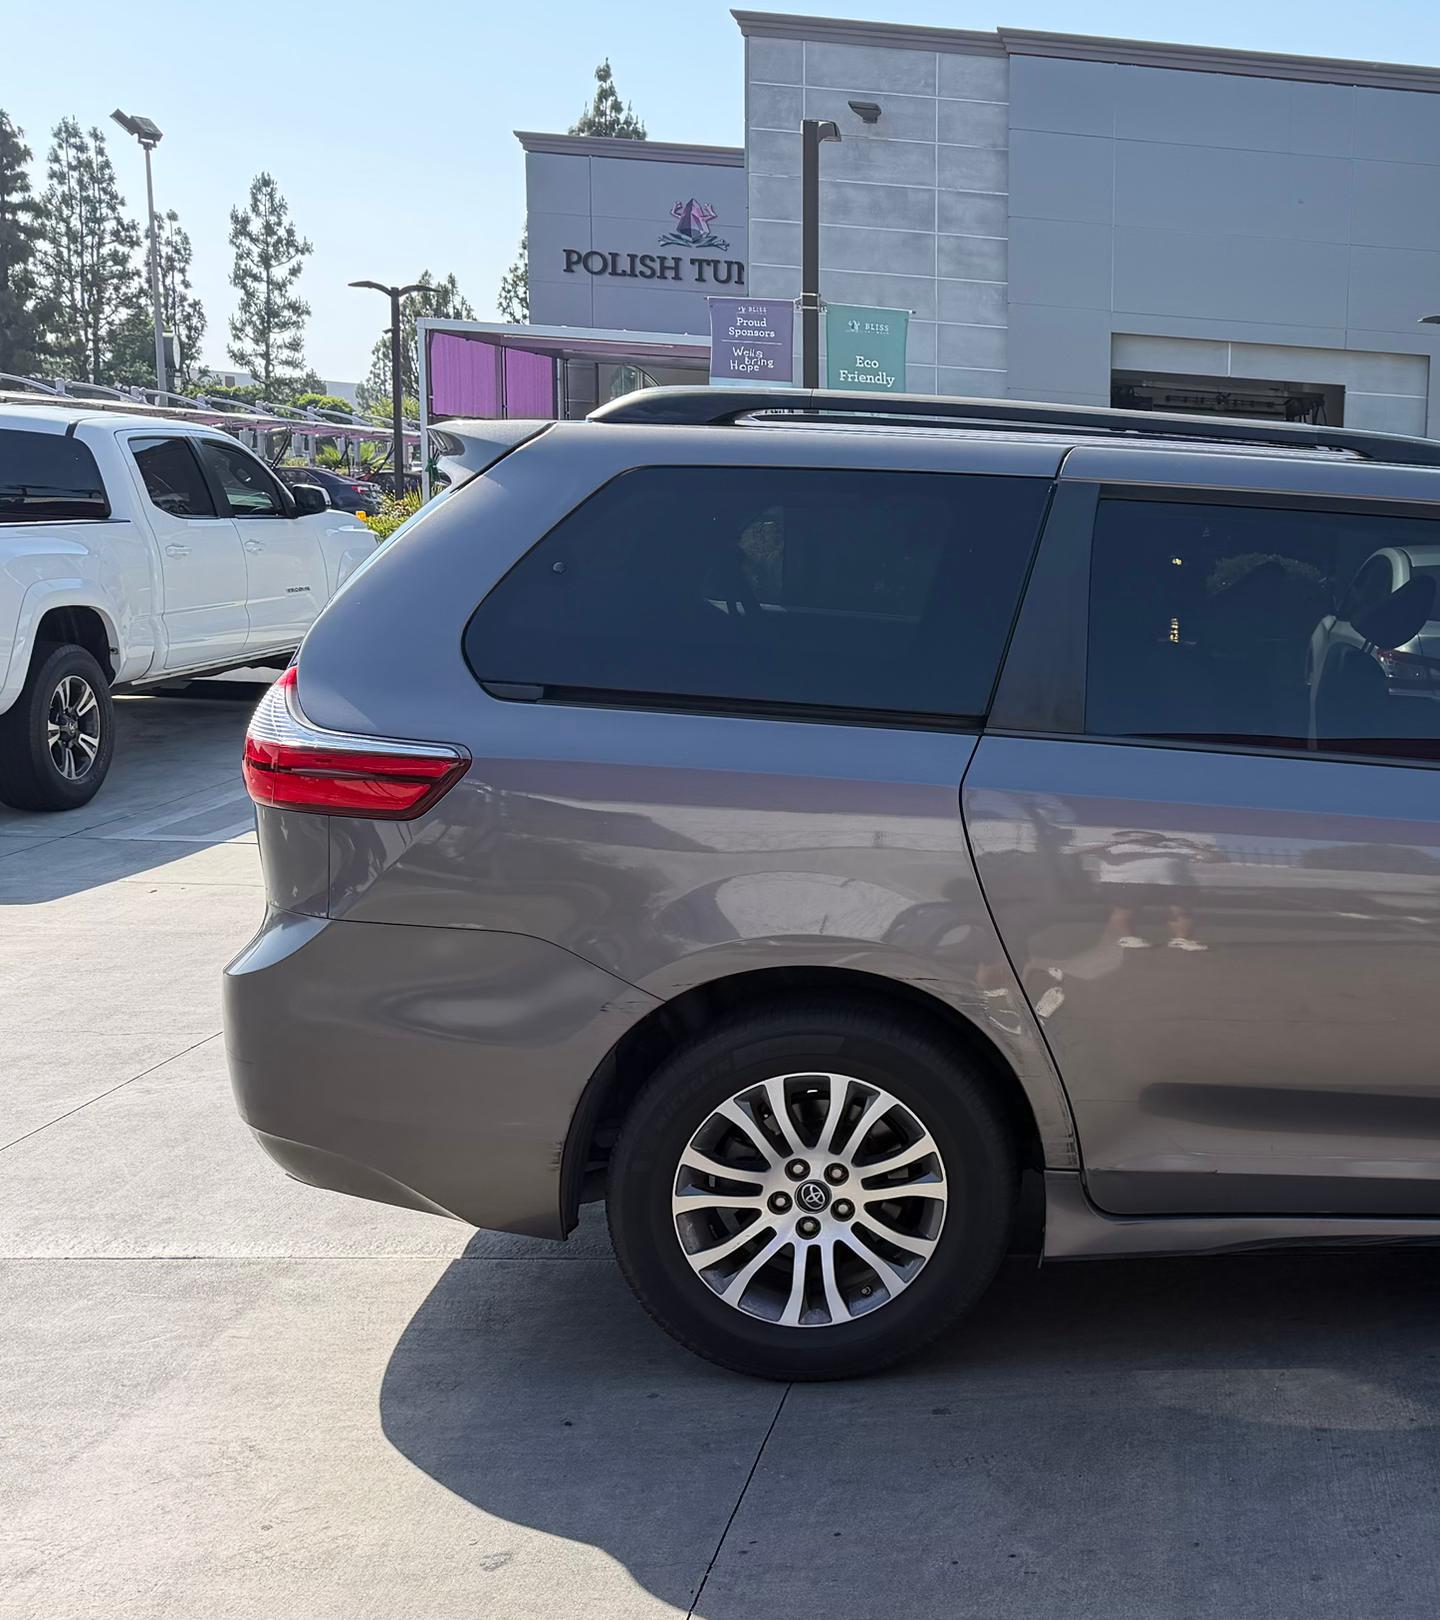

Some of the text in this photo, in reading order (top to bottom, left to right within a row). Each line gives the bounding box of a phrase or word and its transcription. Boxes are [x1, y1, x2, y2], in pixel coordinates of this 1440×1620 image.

[563, 249, 682, 280] POLISH
[736, 317, 767, 327] Proud
[865, 323, 888, 331] BLISS
[728, 327, 775, 338] Sponsors
[732, 345, 763, 358] Wells
[730, 359, 760, 373] Hope
[744, 356, 774, 369] bring
[855, 355, 879, 368] Eco
[839, 369, 895, 388] Friendly
